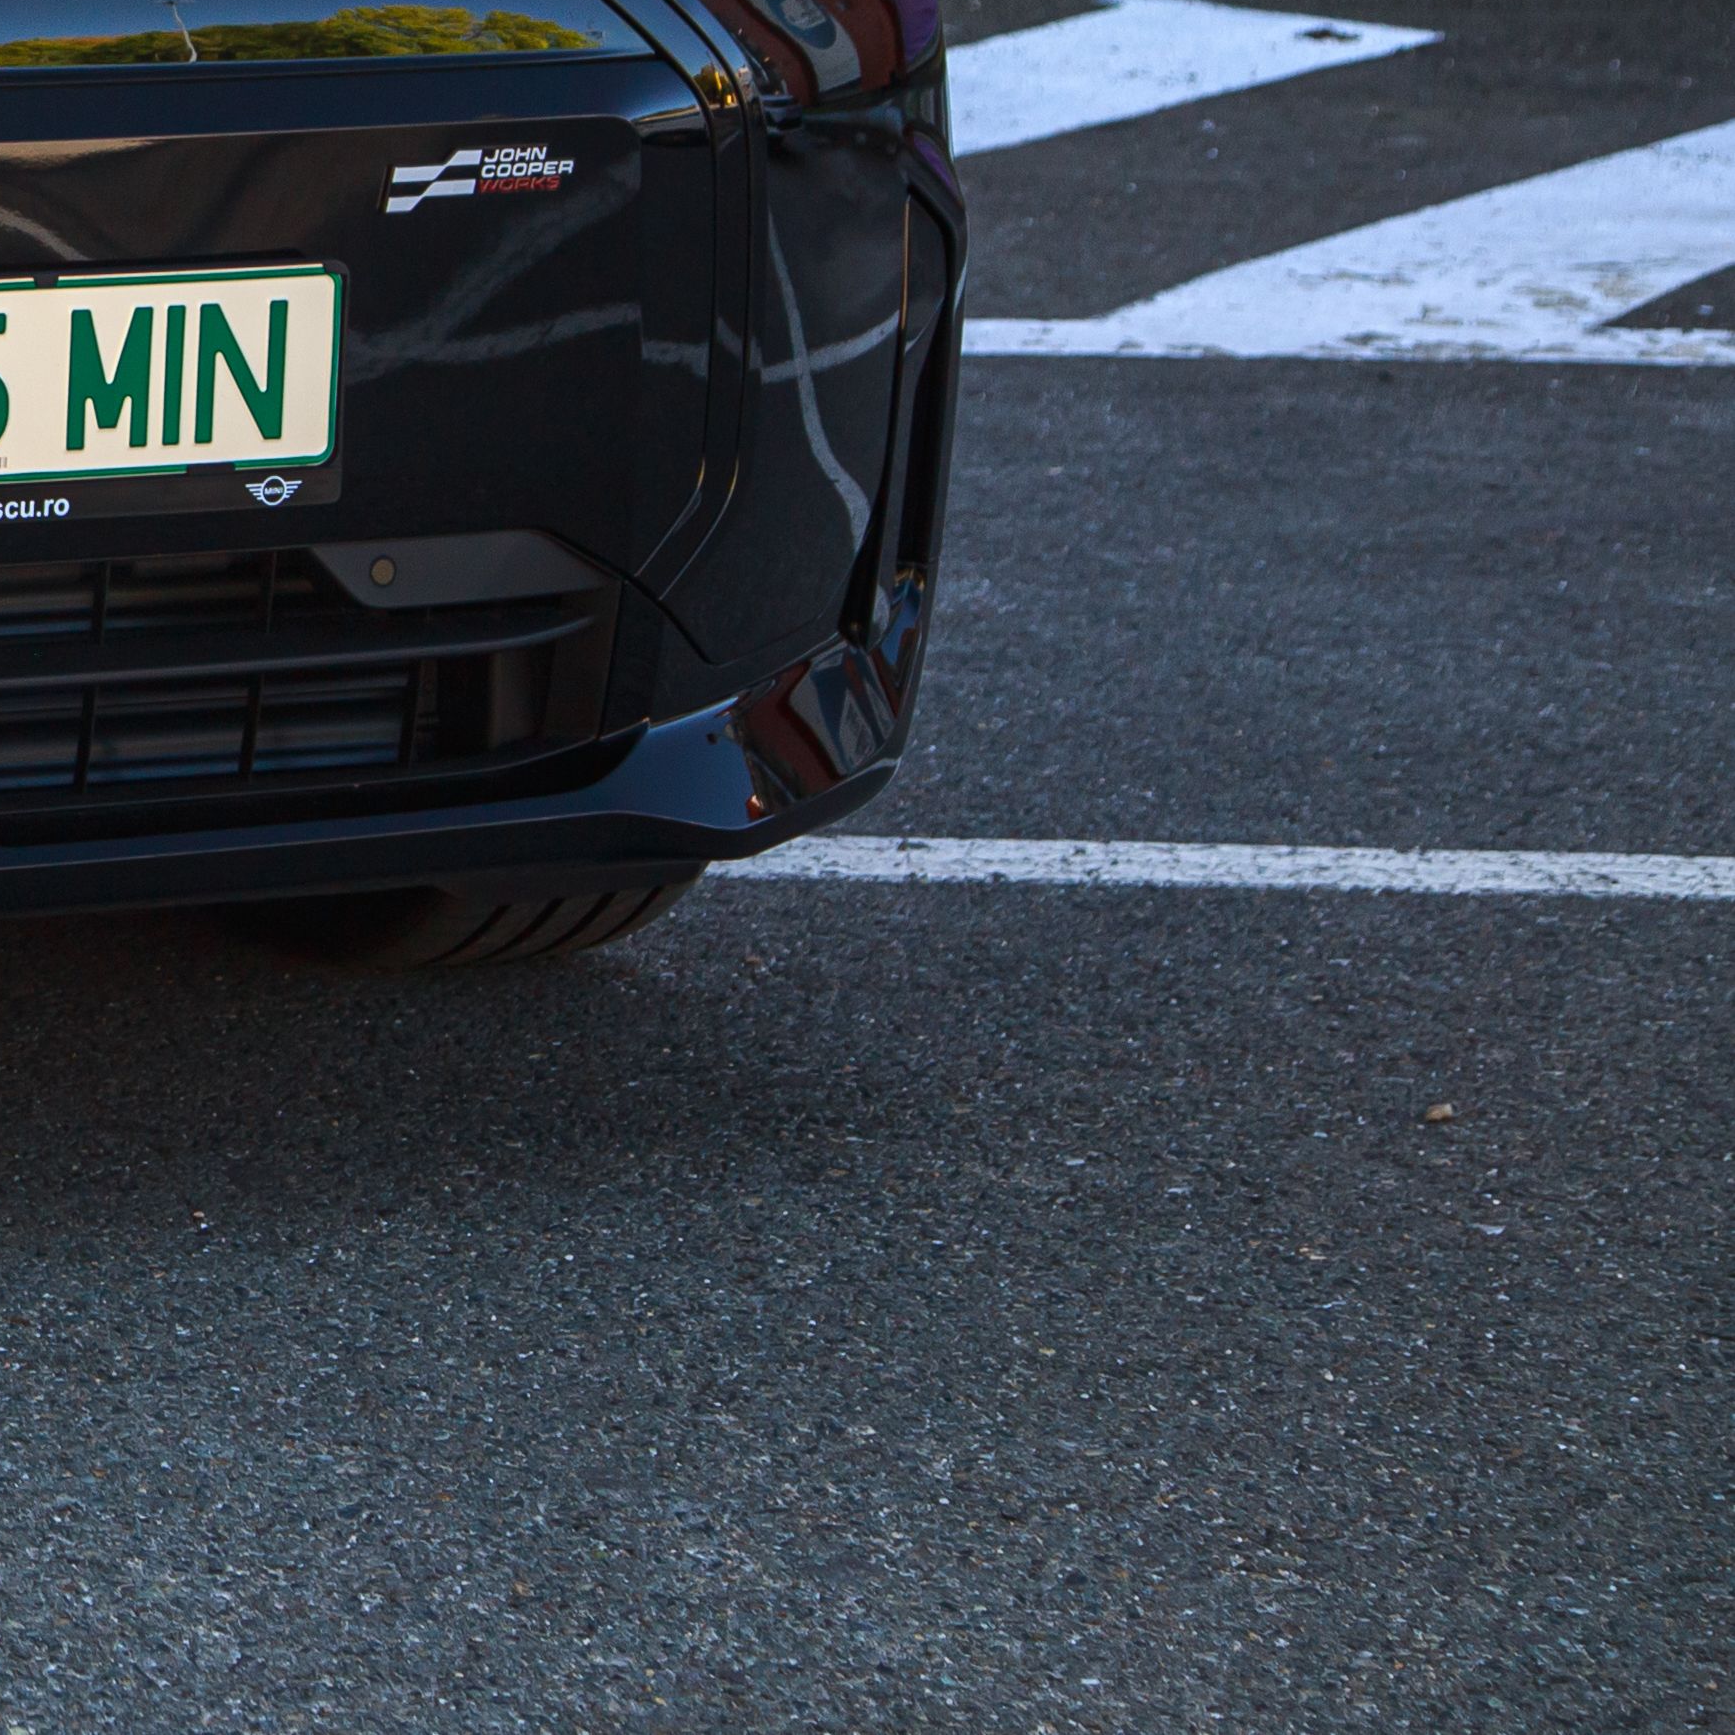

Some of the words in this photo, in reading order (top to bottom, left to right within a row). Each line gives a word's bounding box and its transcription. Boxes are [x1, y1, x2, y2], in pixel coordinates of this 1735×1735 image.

[483, 146, 547, 163] JOHN
[481, 160, 574, 178] COOPER
[480, 176, 561, 193] WORKS
[66, 299, 290, 451] MIN
